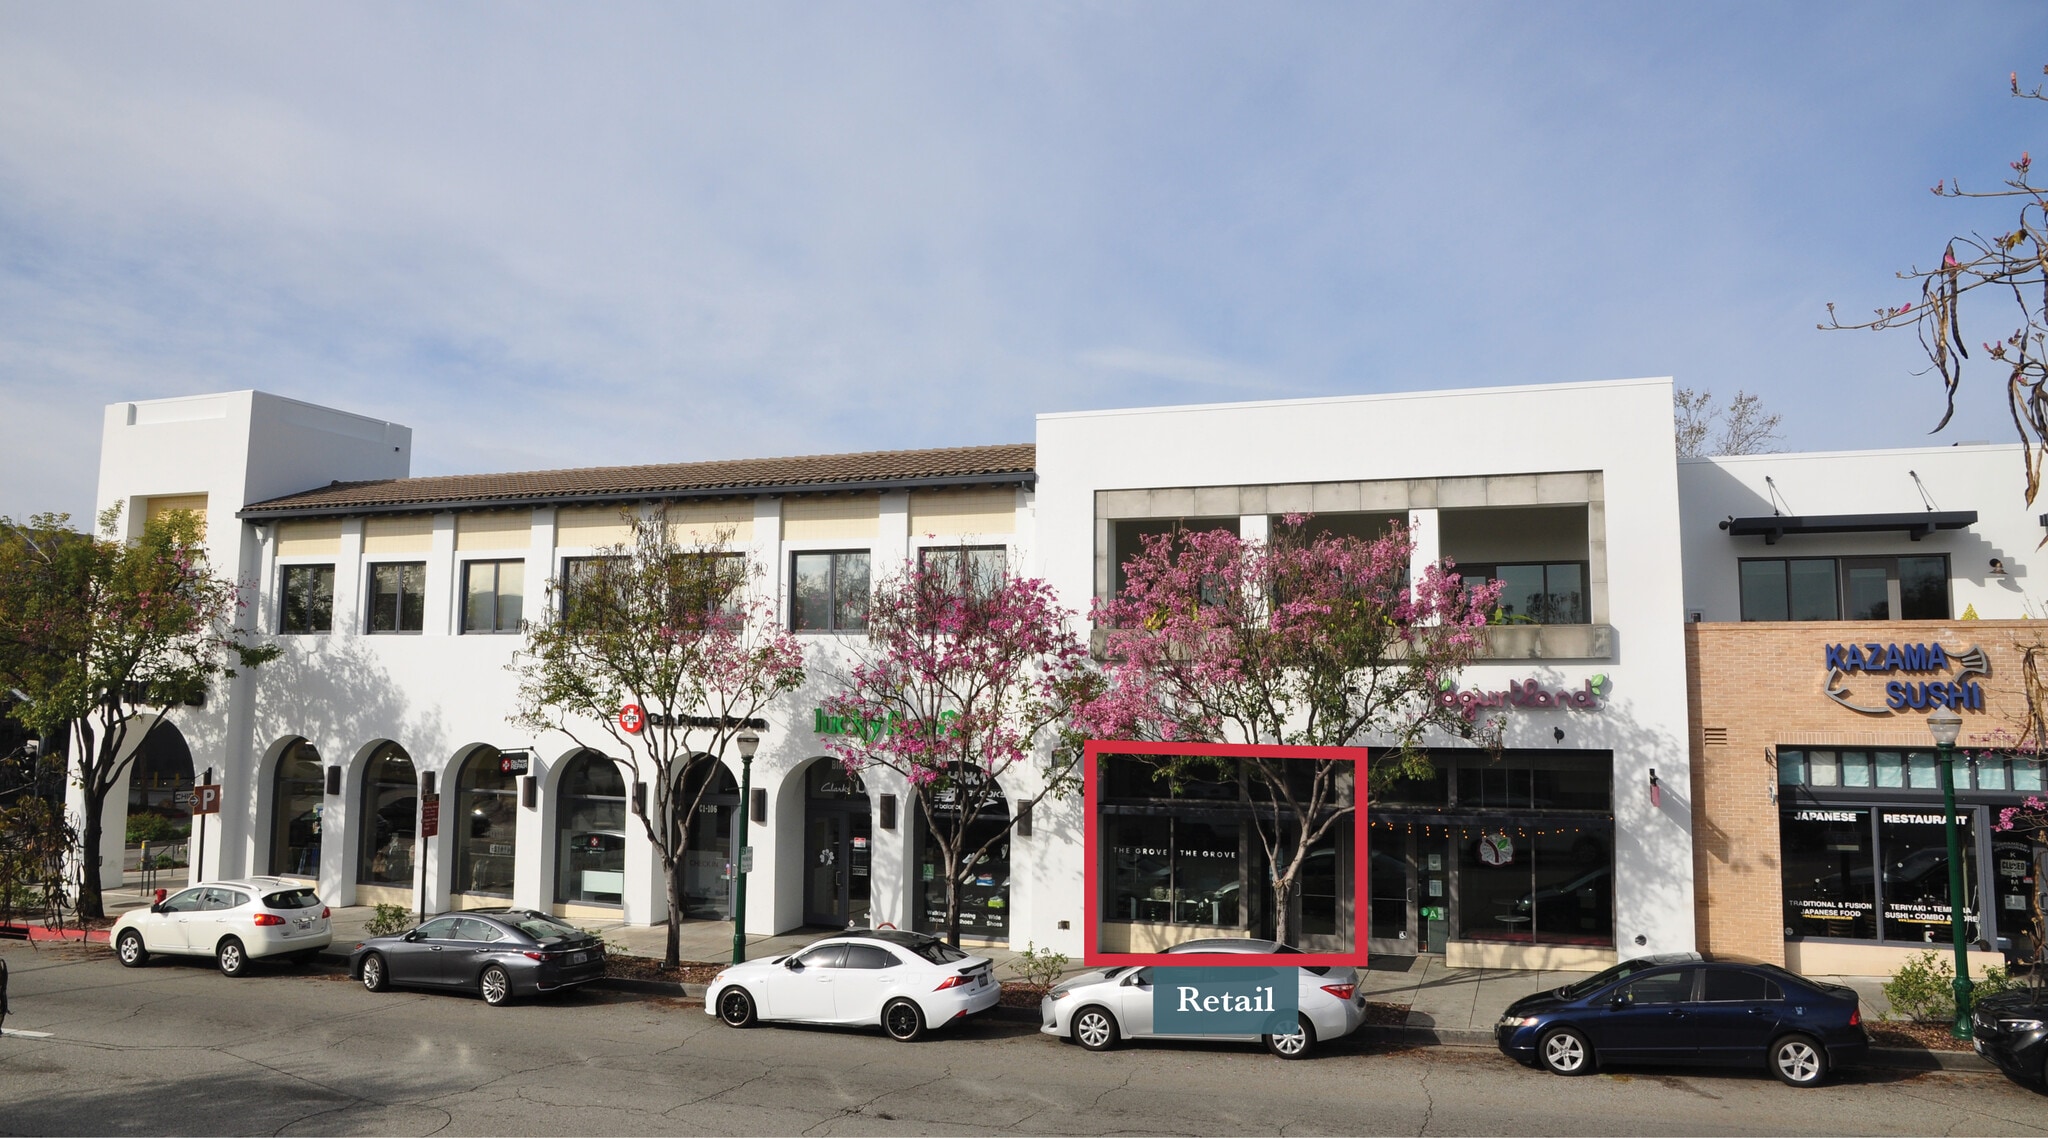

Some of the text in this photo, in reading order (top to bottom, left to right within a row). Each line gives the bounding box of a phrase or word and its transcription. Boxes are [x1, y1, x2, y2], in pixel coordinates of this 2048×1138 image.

[1826, 643, 1948, 670] KAZAMA
[1434, 678, 1597, 722] ogurtland
[1886, 681, 1981, 708] SUSHI
[814, 708, 882, 746] lucky
[203, 789, 216, 810] P
[1794, 811, 1857, 822] JAPANESE
[1135, 848, 1168, 856] GROVE
[1202, 850, 1236, 859] GROVE
[1789, 900, 1836, 908] TRADITIONAL
[1890, 903, 1926, 912] TERIYAKI
[1884, 911, 1909, 919] SUSHI
[1915, 913, 1945, 921] COMBO
